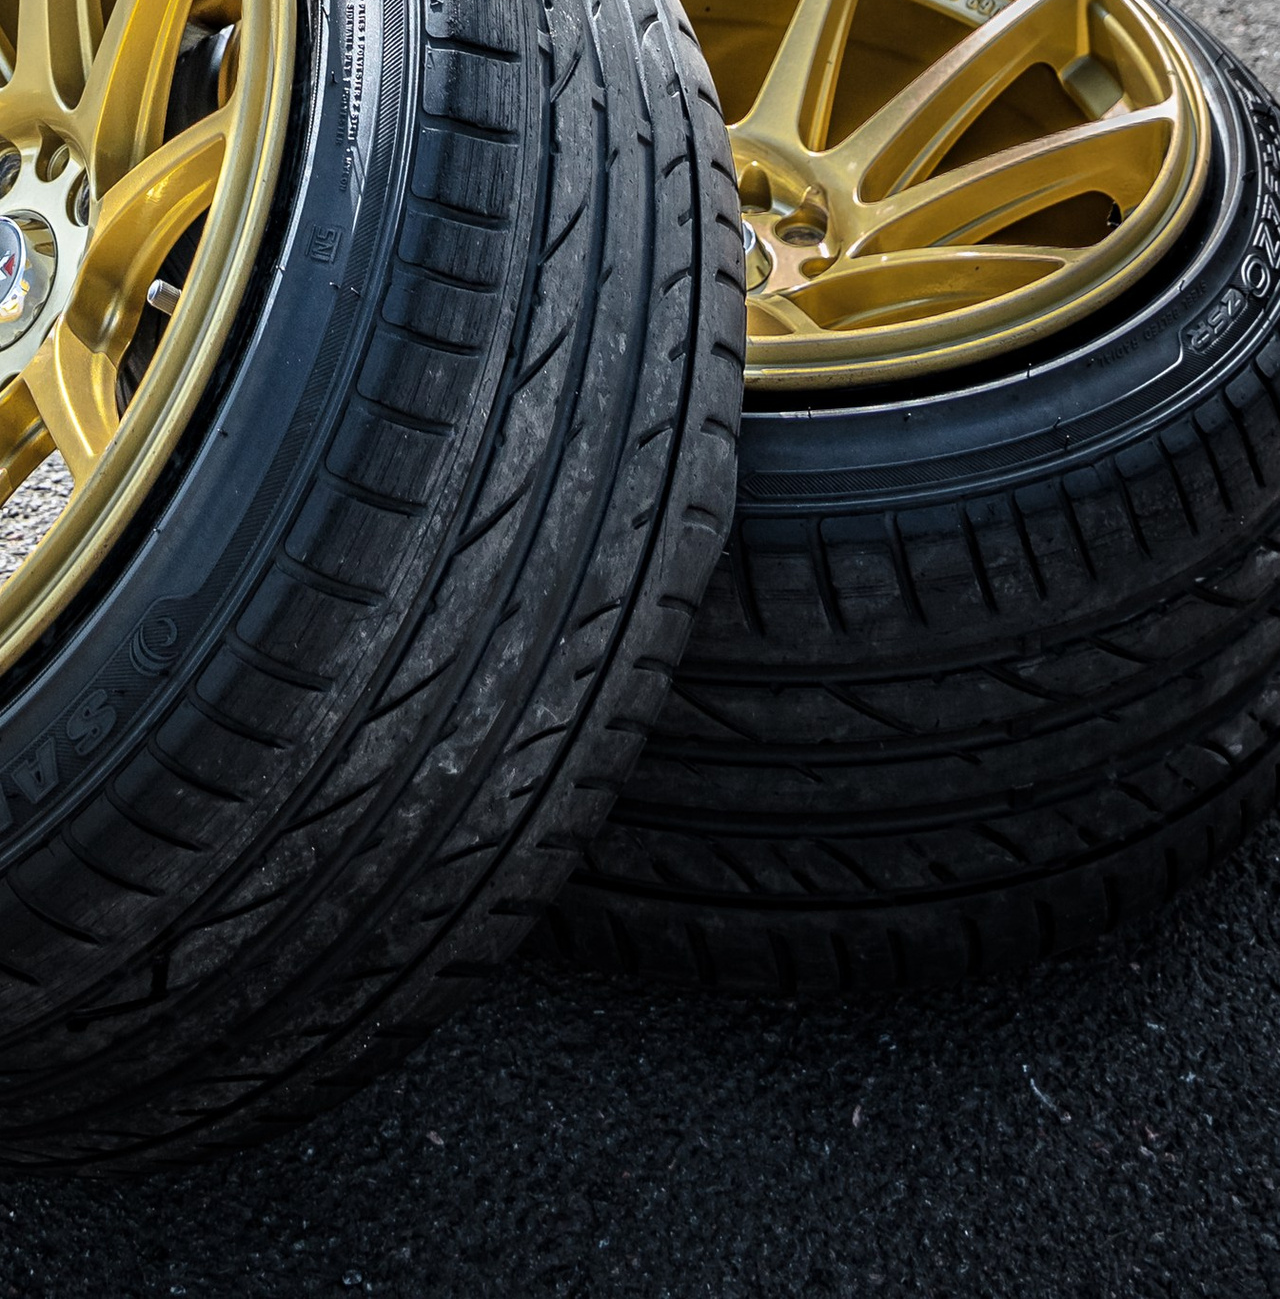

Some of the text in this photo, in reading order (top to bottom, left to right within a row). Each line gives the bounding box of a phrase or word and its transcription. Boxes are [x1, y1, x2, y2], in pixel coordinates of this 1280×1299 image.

[345, 3, 354, 48] SIDEWALL
[354, 44, 365, 97] POLYESTER
[1097, 280, 1208, 368] STEEL BELTED RADIAL
[1188, 287, 1248, 352] ZSR
